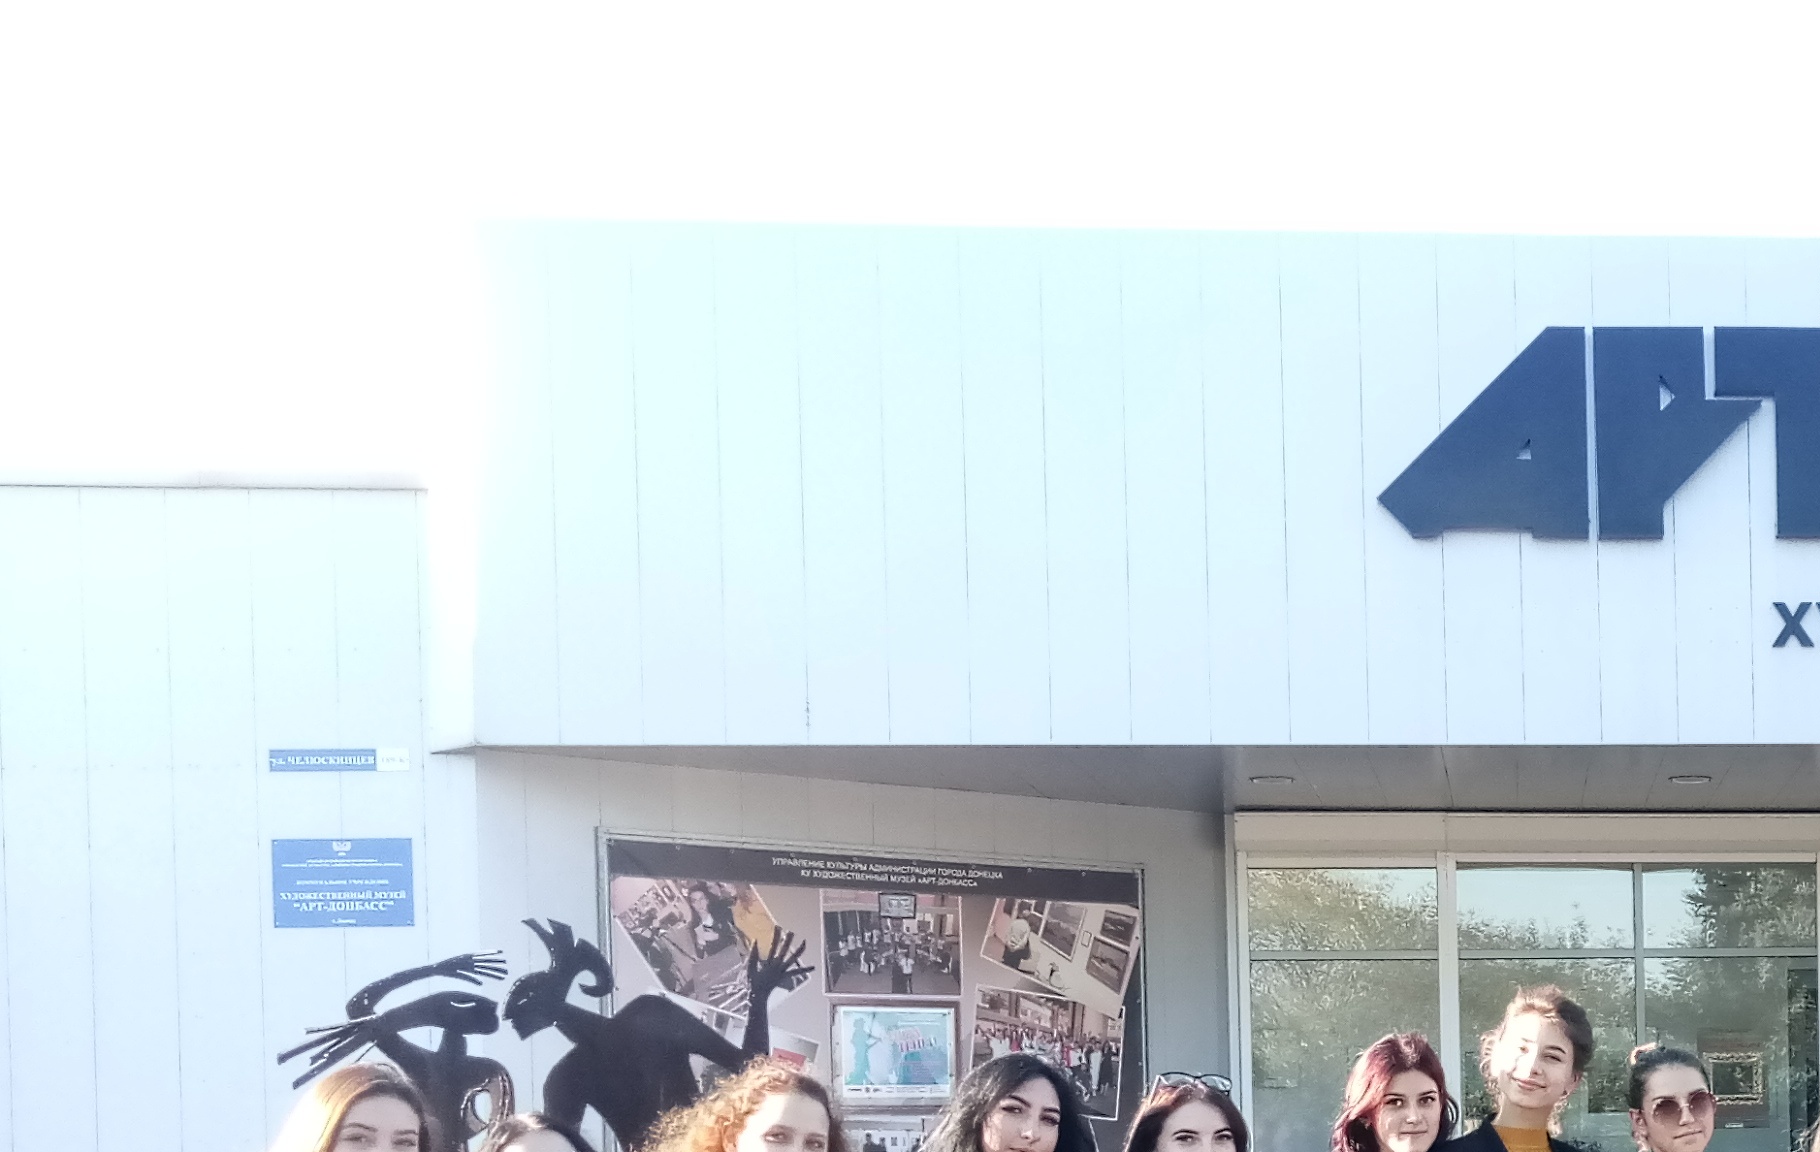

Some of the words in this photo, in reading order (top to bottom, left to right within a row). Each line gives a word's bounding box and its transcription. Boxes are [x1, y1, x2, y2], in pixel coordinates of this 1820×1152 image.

[772, 857, 825, 869] УПРАВЛЕНИЕ
[826, 861, 867, 871] КУЛЬТУРЫ
[938, 867, 967, 877] ГОРОДА
[968, 870, 1003, 880] ДОНЕЦКА
[812, 870, 889, 882] ХУДОЖЕСТВЕННЫЙ
[890, 874, 916, 883] МУЗЕЙ
